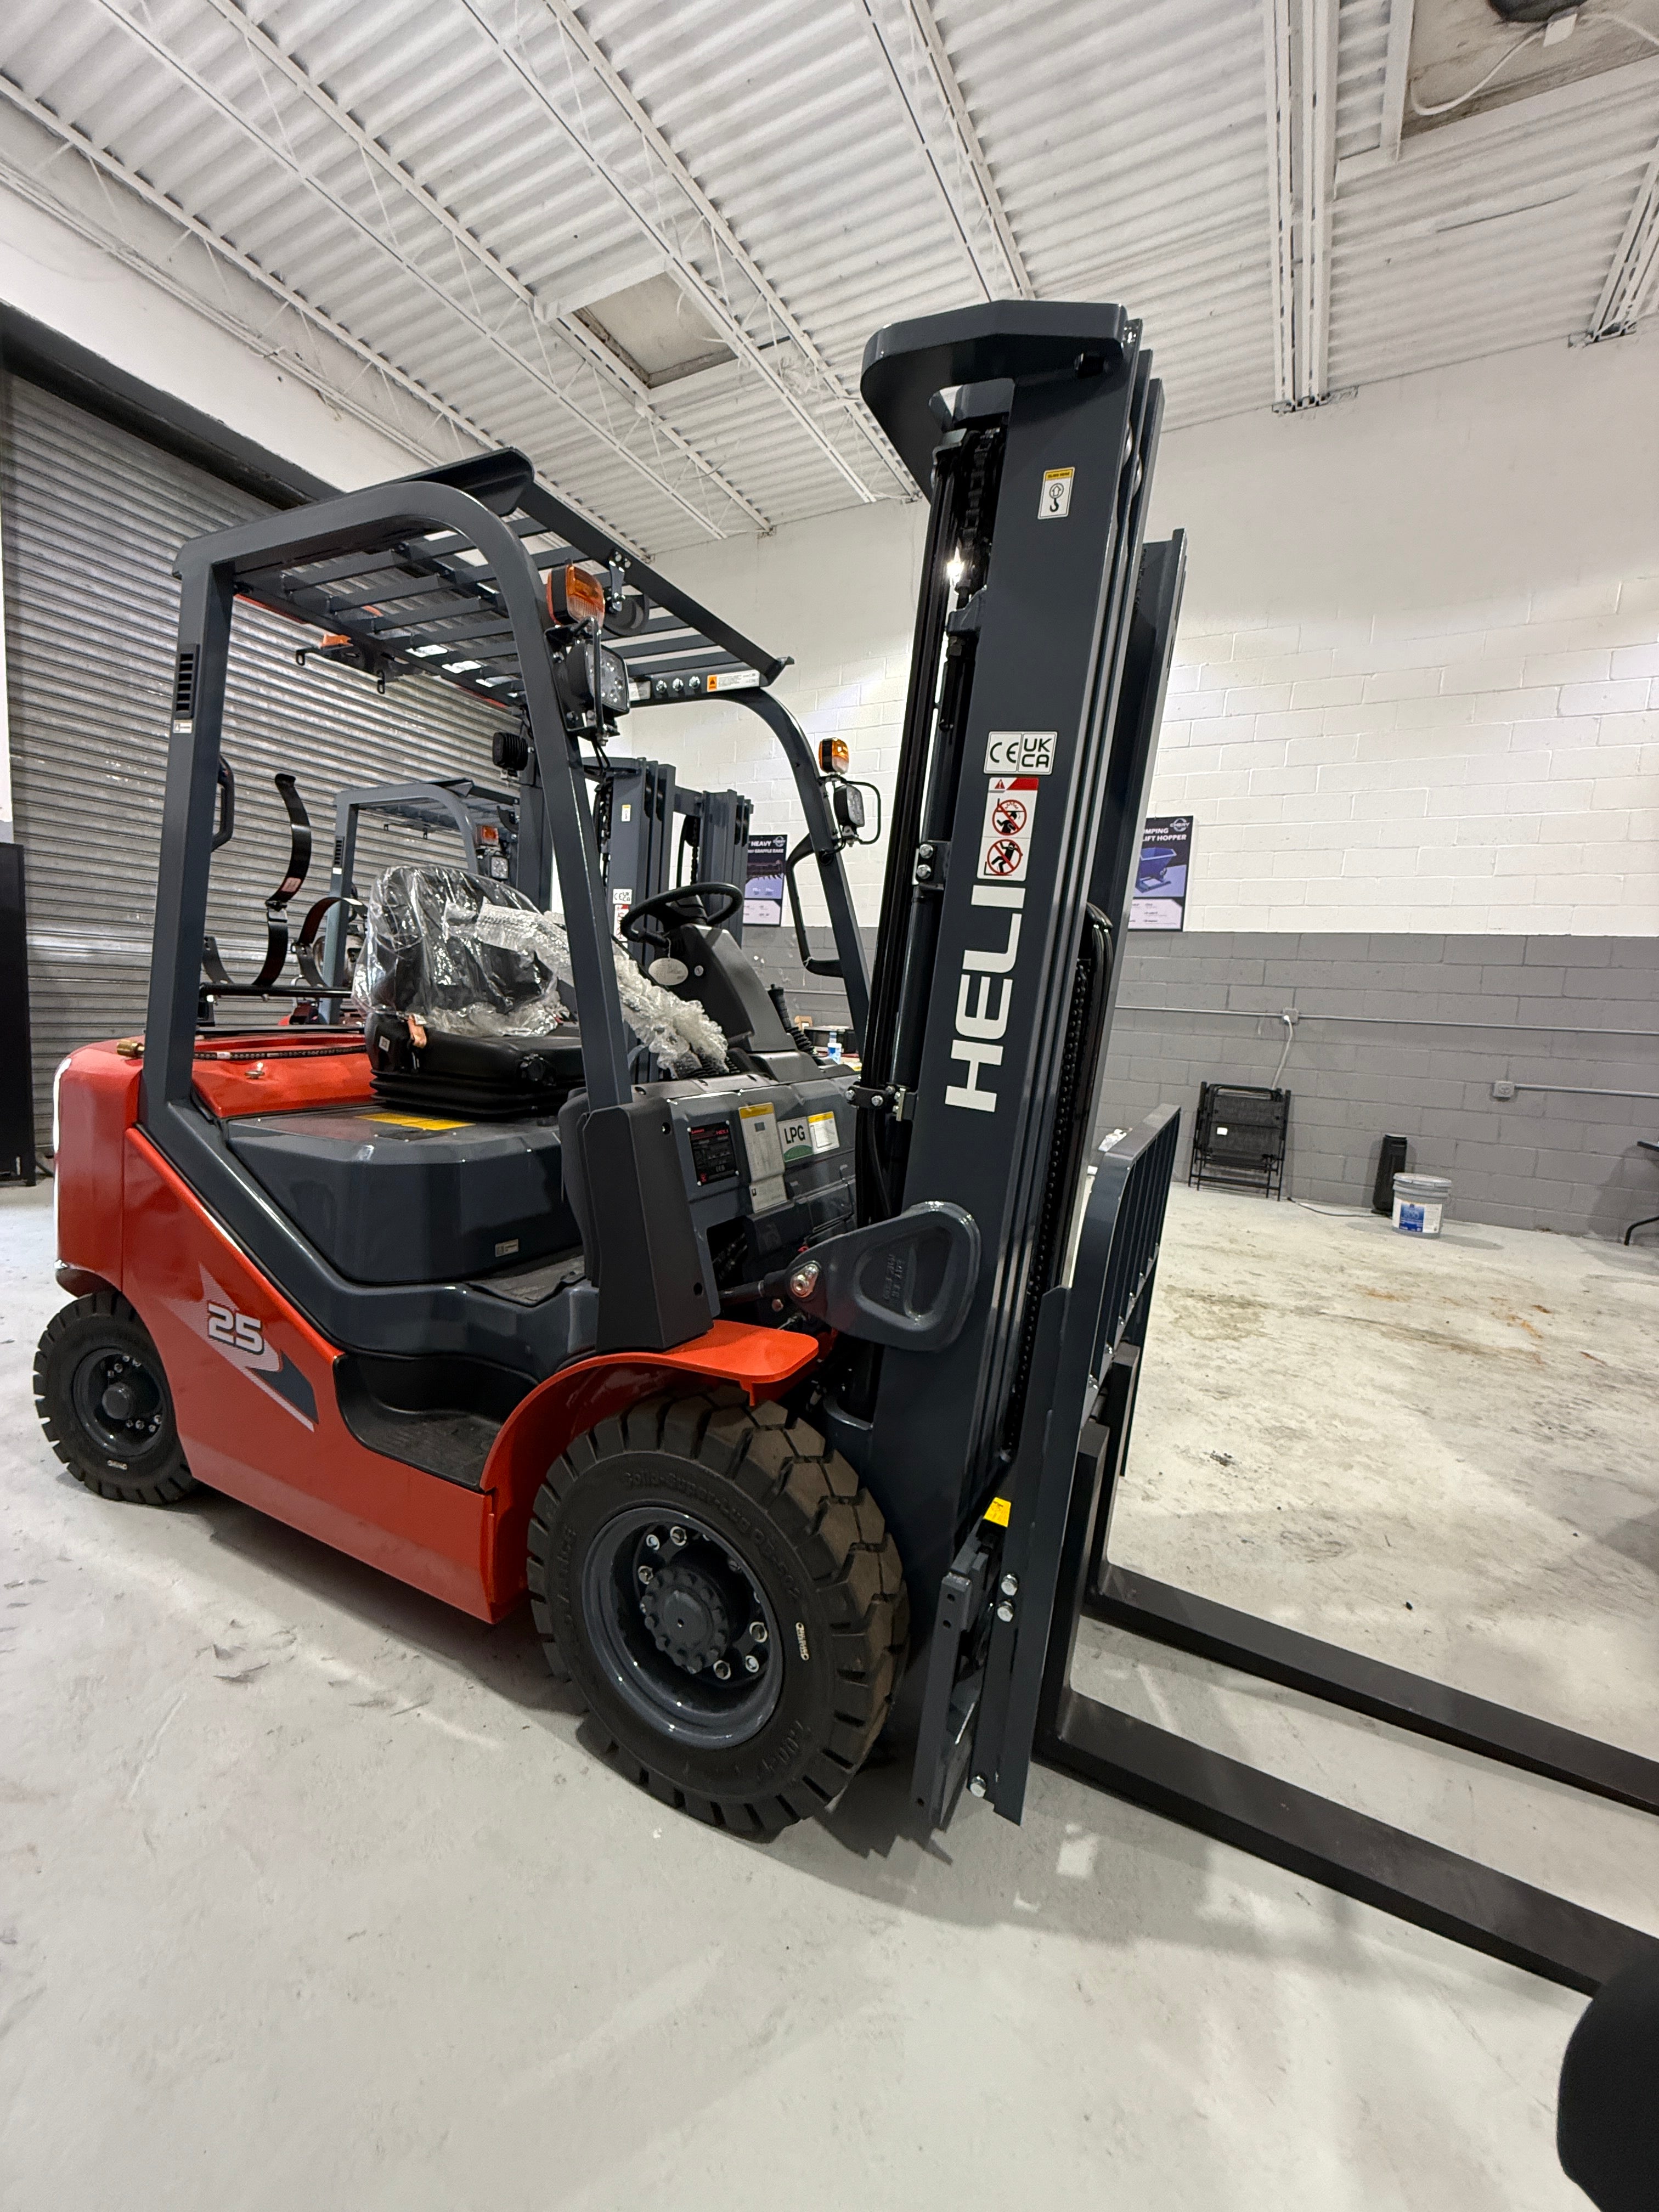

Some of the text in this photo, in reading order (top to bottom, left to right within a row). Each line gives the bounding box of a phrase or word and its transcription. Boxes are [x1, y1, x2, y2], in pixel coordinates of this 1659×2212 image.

[990, 742, 1019, 764] CE
[1024, 738, 1052, 753] UK
[1021, 754, 1050, 768] CA
[945, 885, 1026, 1113] HELI
[784, 1125, 806, 1144] LPG
[208, 1302, 264, 1355] 25
